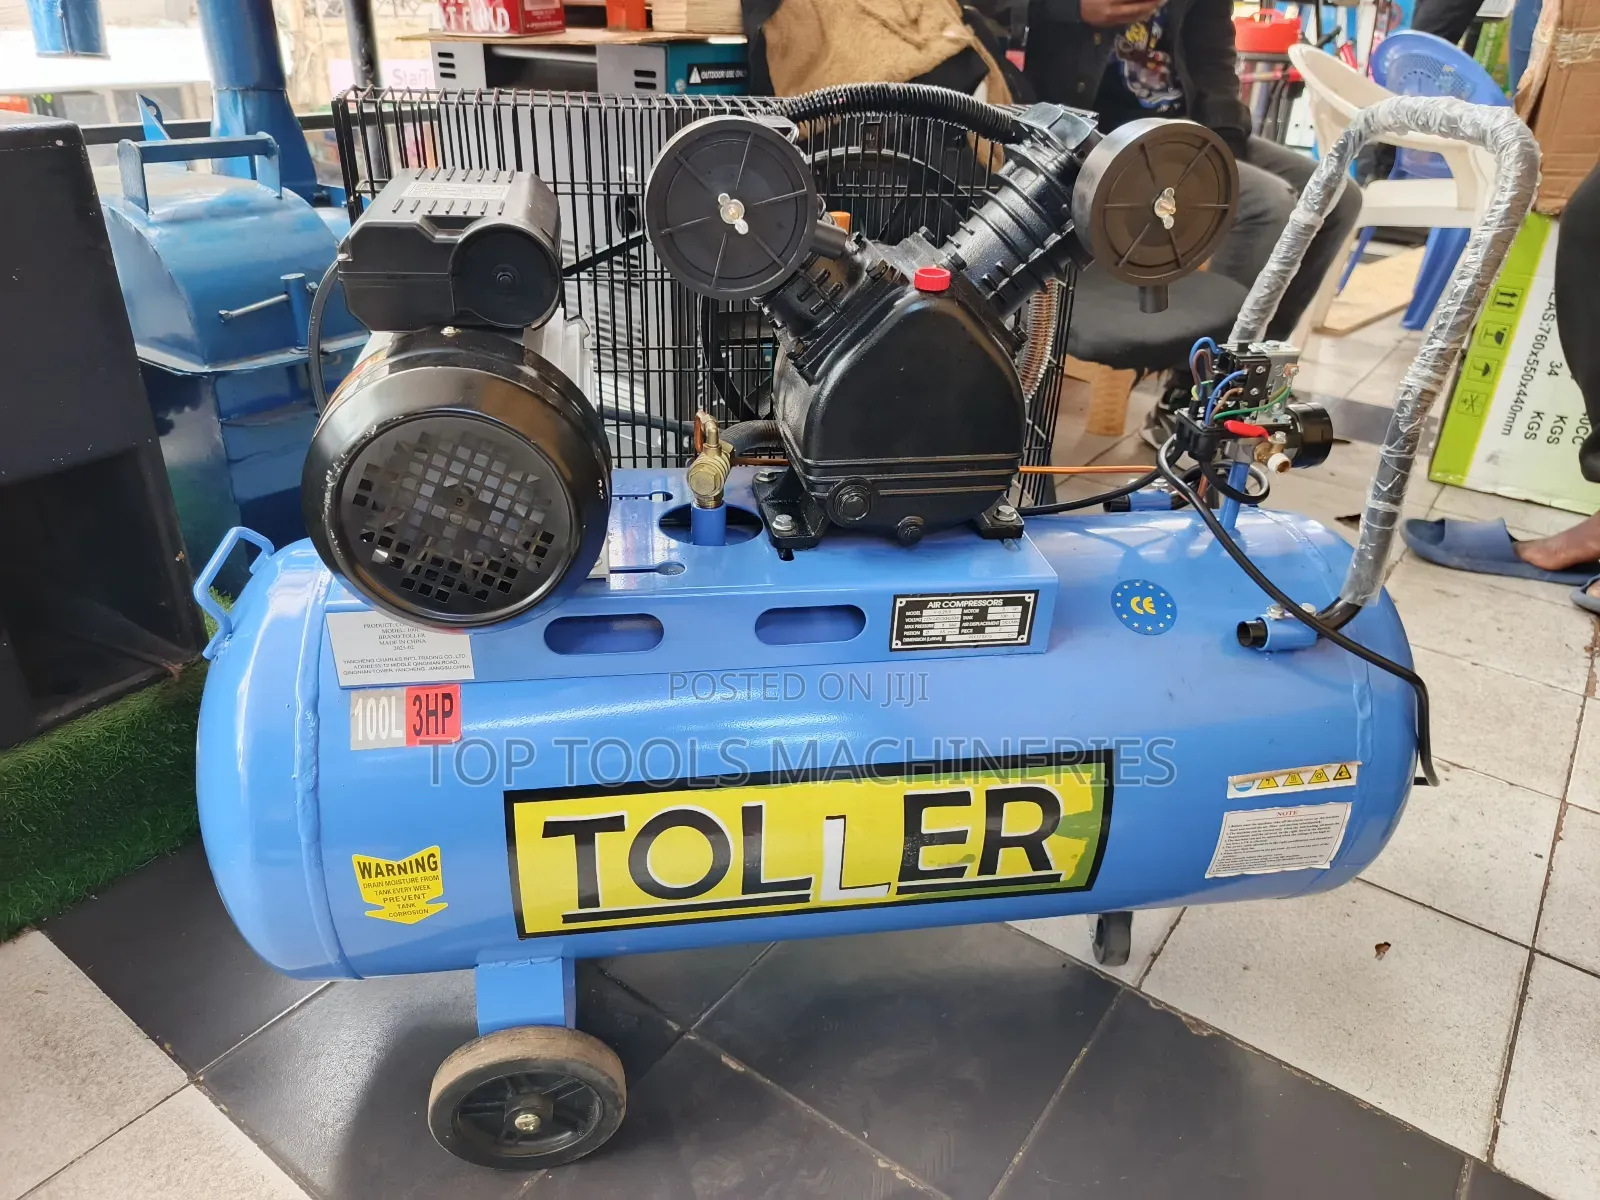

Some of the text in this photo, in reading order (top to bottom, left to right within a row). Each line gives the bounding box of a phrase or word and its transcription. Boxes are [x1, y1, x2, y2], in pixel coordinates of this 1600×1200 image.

[1524, 360, 1563, 441] 34 KGS
[1546, 414, 1569, 445] KGS
[926, 599, 1004, 609] AIR COMPRESSORS
[1130, 596, 1156, 615] CE
[354, 692, 454, 741] 100L 3HP
[541, 785, 1064, 910] TOLLER
[357, 852, 439, 880] WARNING
[362, 874, 440, 890] DRAIN MOISTURE FROM
[374, 883, 432, 896] TANK EVERY WEEK
[383, 892, 427, 903] PREVENT
[397, 902, 417, 910] TANK
[388, 908, 429, 918] CORROSION
